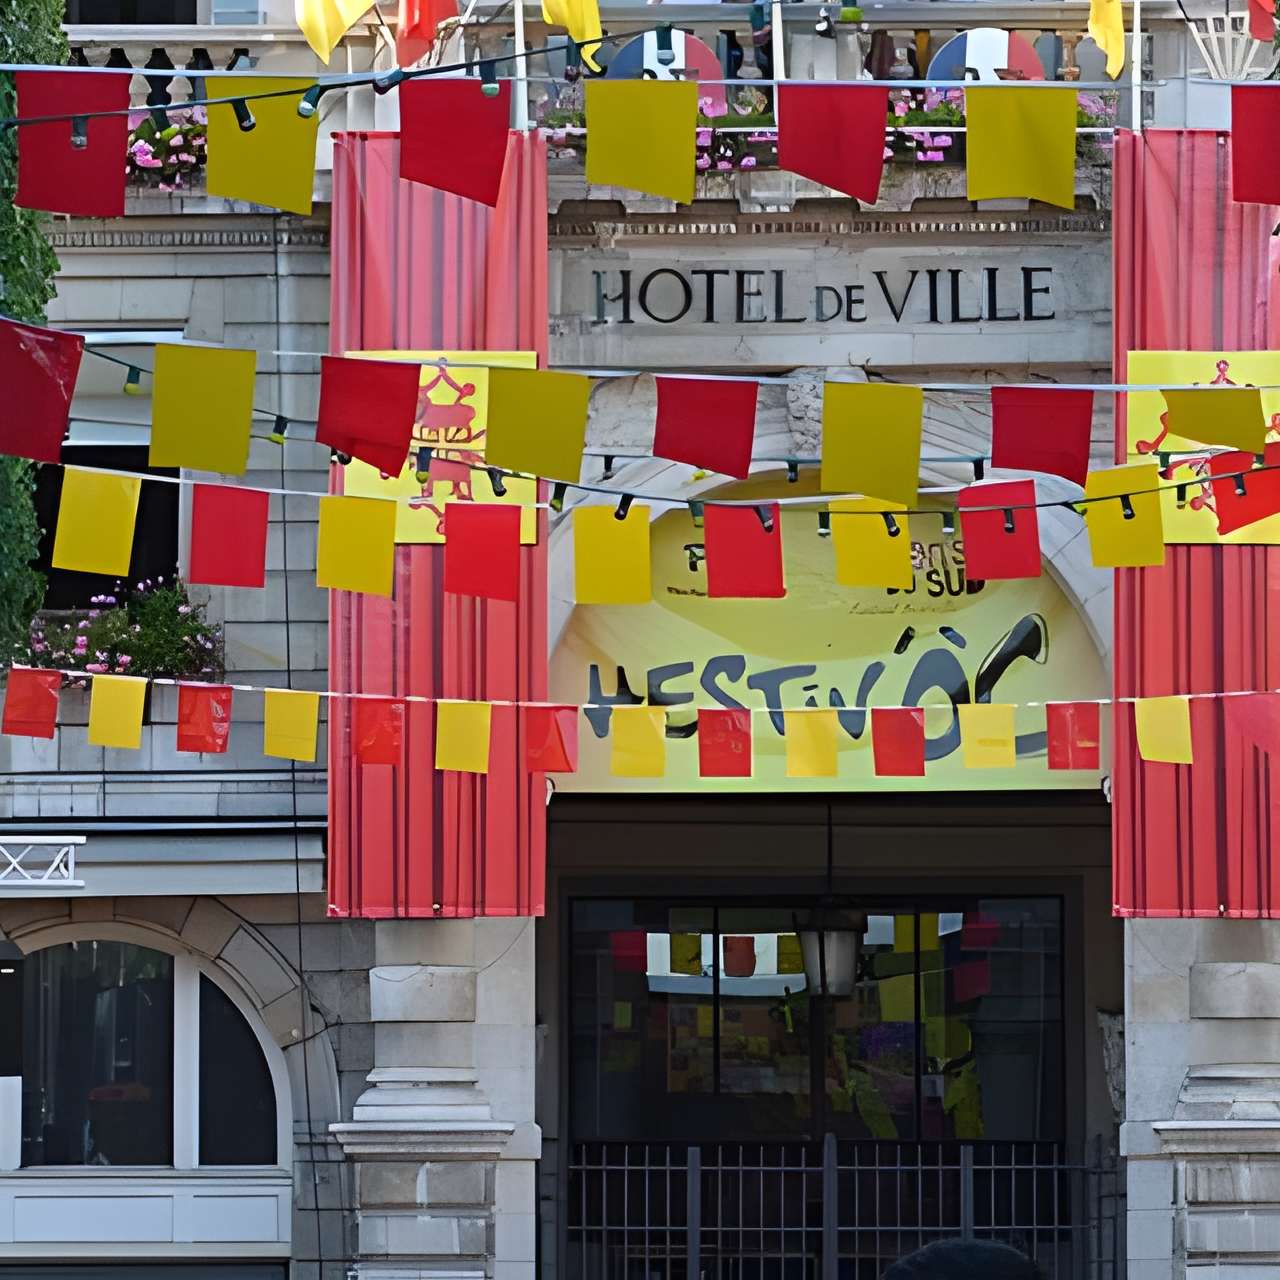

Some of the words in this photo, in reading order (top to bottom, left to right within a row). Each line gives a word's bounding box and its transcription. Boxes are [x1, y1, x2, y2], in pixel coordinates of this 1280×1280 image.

[591, 268, 807, 324] HOTEL
[815, 284, 868, 322] DE
[872, 266, 1057, 325] VILLE
